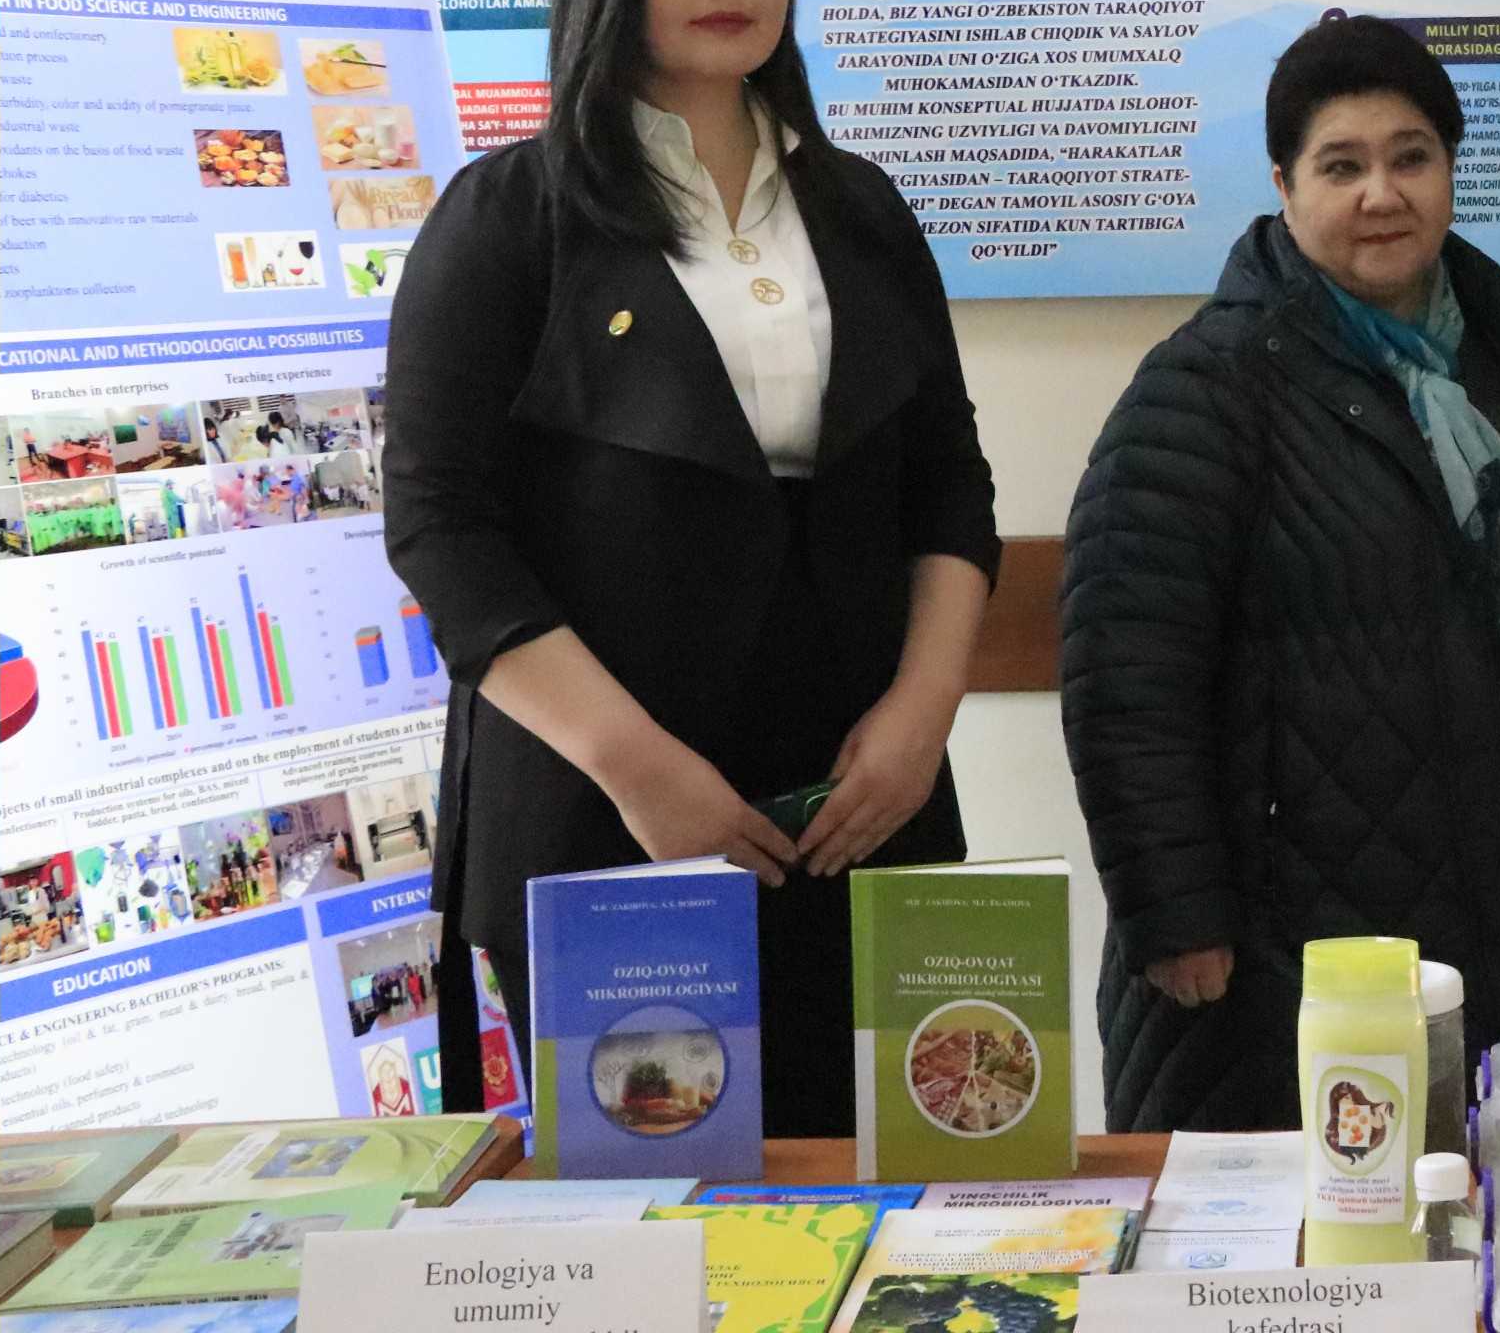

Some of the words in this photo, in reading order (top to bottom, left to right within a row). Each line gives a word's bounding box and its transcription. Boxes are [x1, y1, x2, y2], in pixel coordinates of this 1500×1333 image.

[87, 0, 149, 15] SCIENCE
[153, 2, 185, 16] AND
[189, 4, 288, 23] ENGINEERING
[823, 8, 884, 20] HOLDA,
[890, 7, 917, 19] BIZ
[923, 6, 972, 18] YANGI
[1095, 1, 1205, 16] TARAQQIYOT
[825, 30, 961, 44] STRATEGIYASINI
[966, 29, 1026, 41] ISHLAB
[1031, 27, 1104, 41] CHIQDIK
[1110, 27, 1128, 38] VA
[1133, 25, 1199, 38] SAYLOV
[838, 54, 943, 68] JARAYONIDA
[949, 53, 976, 65] UNI
[1044, 52, 1077, 63] XOS
[1083, 49, 1181, 63] UMUMXALQ
[83, 344, 119, 361] AND
[123, 335, 265, 359] METHODOLOGICAL
[269, 329, 364, 347] POSSIBILITIES
[224, 370, 274, 386] Teaching
[276, 366, 332, 384] experience
[31, 385, 87, 401] Branches
[90, 384, 102, 397] in
[105, 380, 169, 398] enterprises
[35, 798, 47, 809] of
[50, 790, 82, 805] small
[86, 777, 144, 798] industrial
[148, 765, 207, 785] complexes
[212, 759, 232, 772] and
[236, 758, 249, 768] on
[253, 753, 270, 765] the
[343, 736, 353, 747] of
[356, 728, 400, 743] students
[404, 725, 413, 733] at
[416, 721, 432, 731] the
[614, 962, 709, 980] OZIQ-OVQAT
[924, 956, 1016, 970] OZIQ-OVQAT
[53, 957, 151, 997] EDUCATION
[899, 973, 1042, 987] MIKROBIOLOGIYASI
[586, 983, 738, 1001] MIKROBIOLOGIYASI
[35, 1003, 127, 1037] ENGINEERING
[944, 1198, 1111, 1209] MIKROBIOLOGIYASI
[950, 1190, 1049, 1200] VINOCHILIK
[425, 1258, 555, 1289] Enologiya
[566, 1261, 594, 1280] va
[1187, 1276, 1383, 1307] Biotexnologiya
[454, 1295, 560, 1325] umumiy
